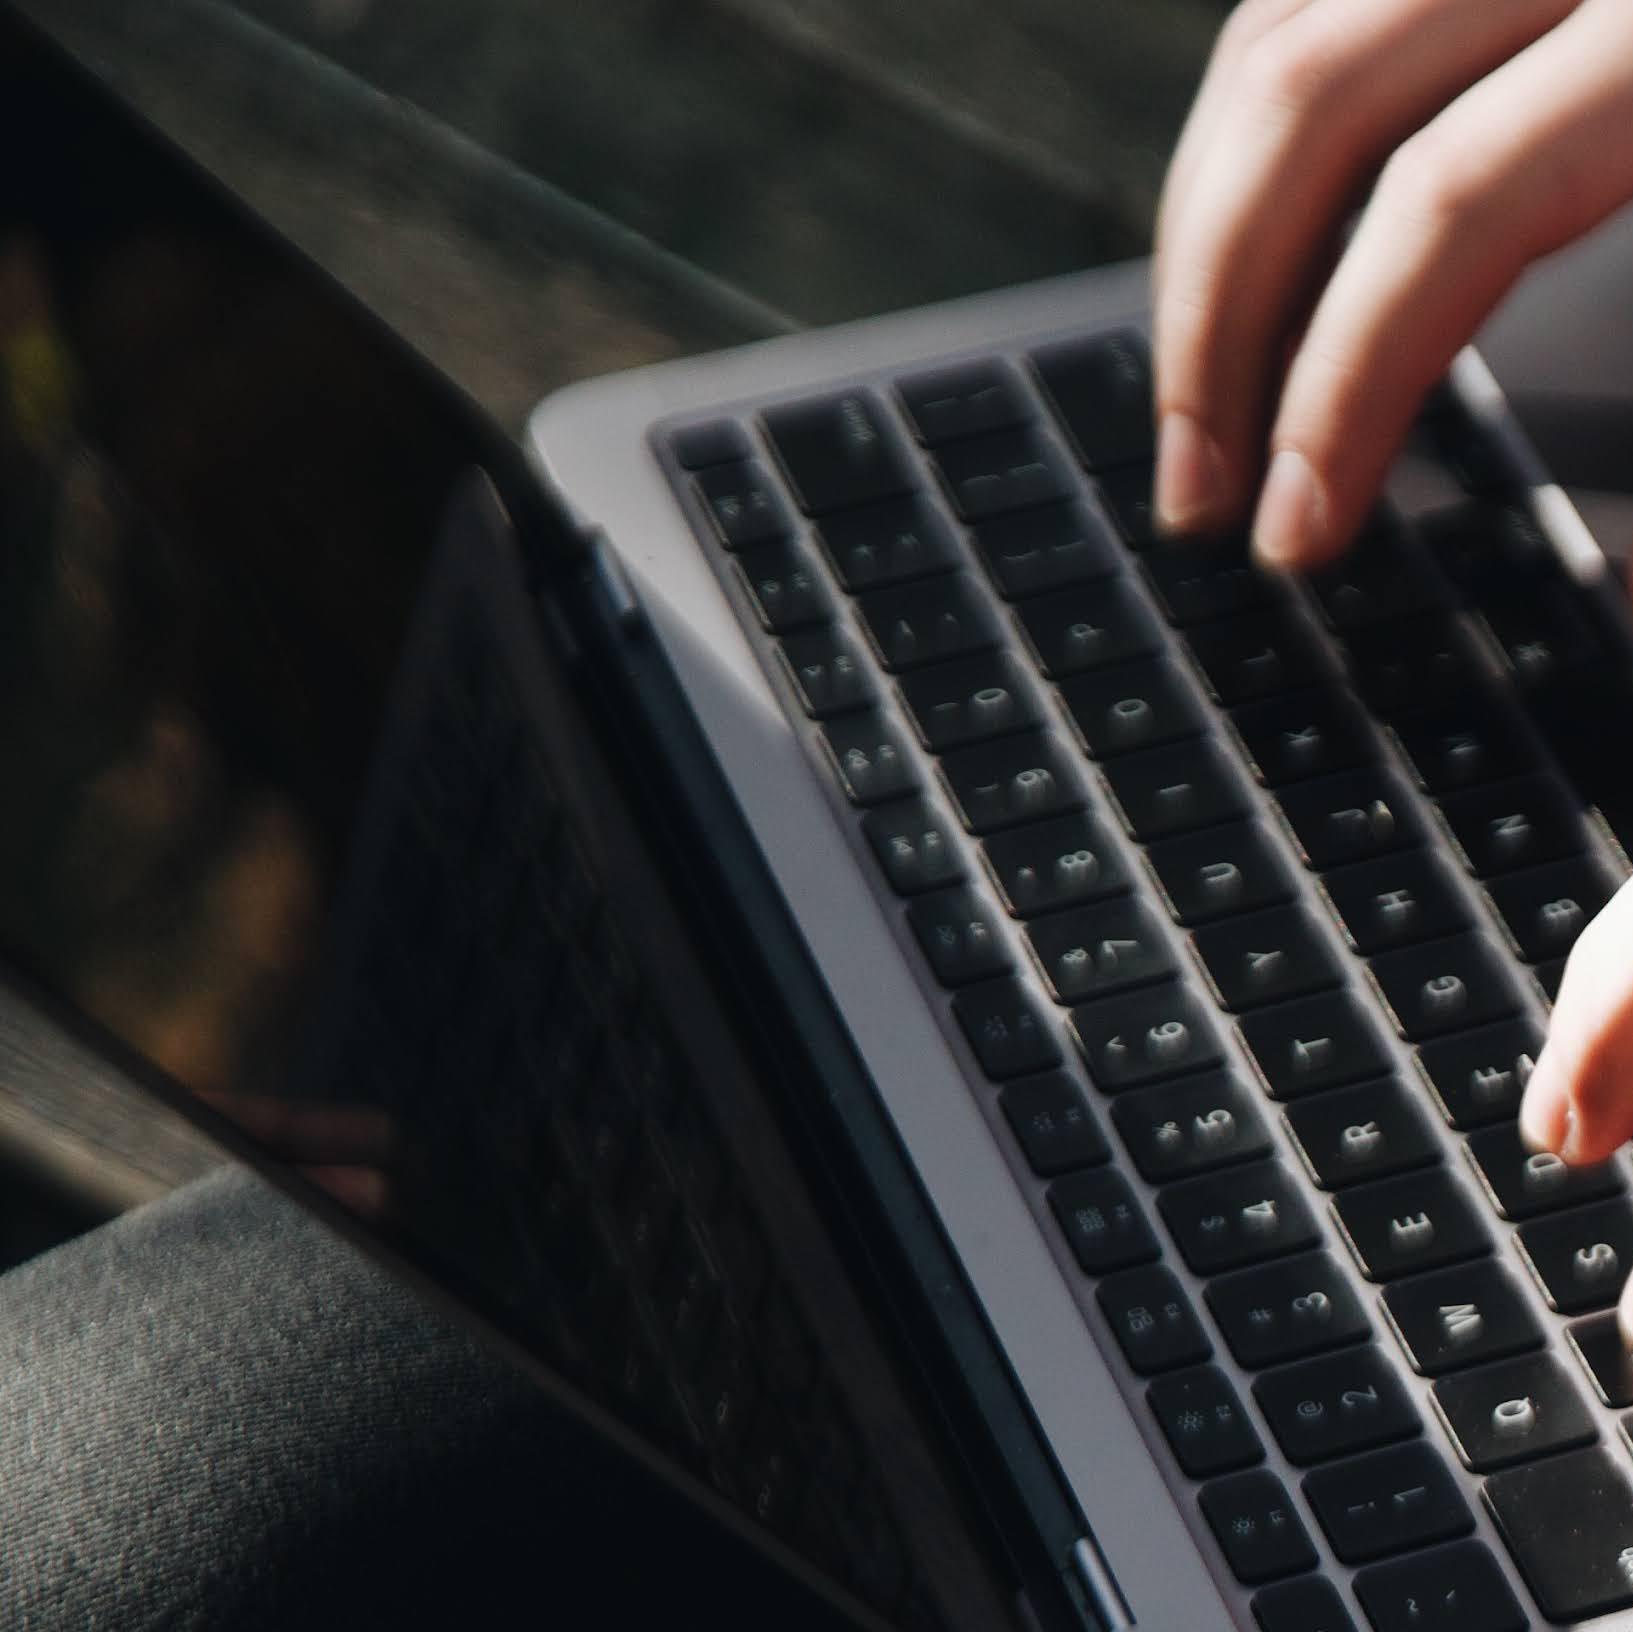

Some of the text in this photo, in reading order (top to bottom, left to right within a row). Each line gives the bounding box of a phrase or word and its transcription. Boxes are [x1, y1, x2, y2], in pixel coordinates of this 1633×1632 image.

[1071, 623, 1104, 638] P
[1112, 698, 1148, 716] O
[1284, 724, 1320, 745] K
[1016, 768, 1051, 786] 9
[1158, 783, 1192, 795] I
[1489, 813, 1533, 834] N
[1058, 850, 1095, 867] 8
[1200, 862, 1237, 882] U
[1376, 888, 1416, 912] H
[1540, 898, 1584, 917] B
[1101, 939, 1138, 956] 7
[1247, 950, 1283, 968] Y
[1424, 975, 1463, 993] G
[1148, 1021, 1187, 1040] 6
[1294, 1037, 1331, 1056] T
[1471, 1065, 1511, 1083] F
[1194, 1109, 1233, 1128] 5
[1343, 1121, 1382, 1144] R
[1526, 1152, 1567, 1173] D
[1242, 1200, 1275, 1216] 4
[1391, 1211, 1433, 1231] E
[1574, 1242, 1617, 1263] S
[1292, 1291, 1328, 1311] 3
[1439, 1303, 1484, 1331] W
[1342, 1385, 1378, 1406] 2
[1493, 1396, 1533, 1421] Q
[1393, 1486, 1426, 1504] 1
